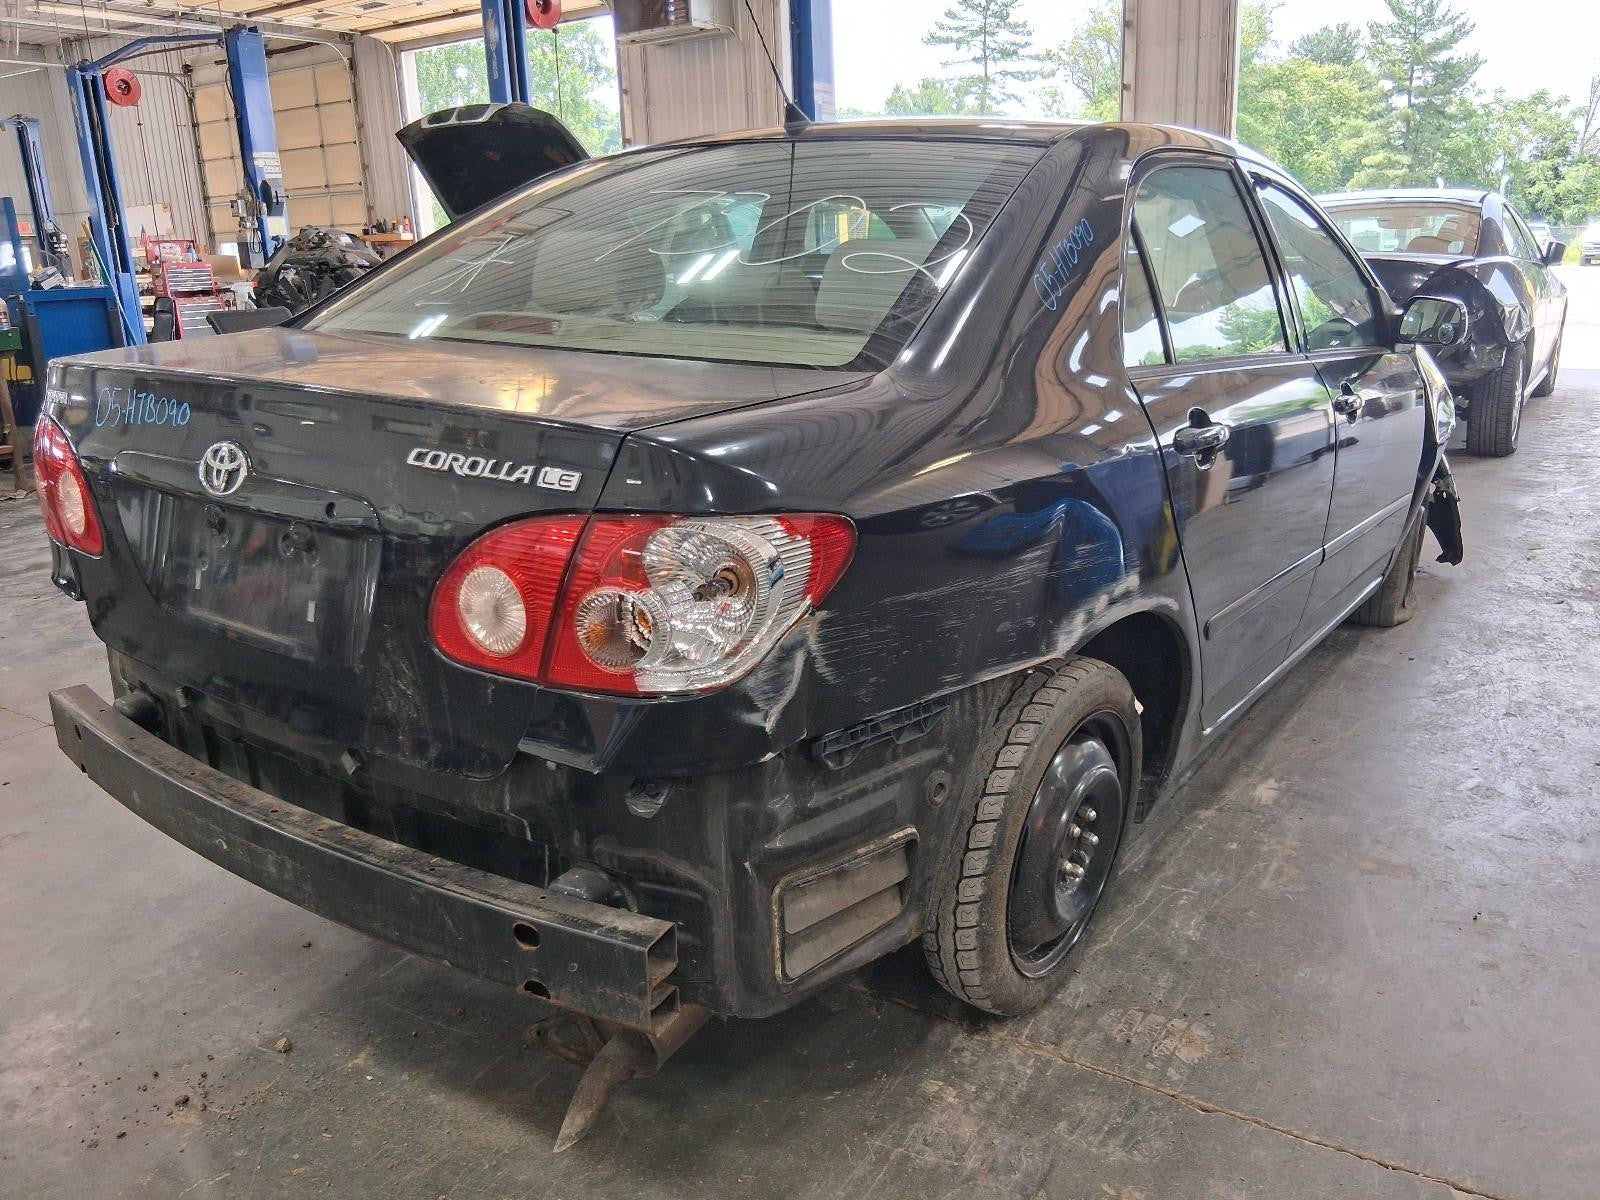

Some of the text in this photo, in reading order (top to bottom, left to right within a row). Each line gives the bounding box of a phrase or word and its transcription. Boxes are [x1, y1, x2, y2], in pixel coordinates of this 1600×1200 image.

[95, 387, 191, 427] 05-HTB090
[406, 447, 578, 490] COROLLA LE
